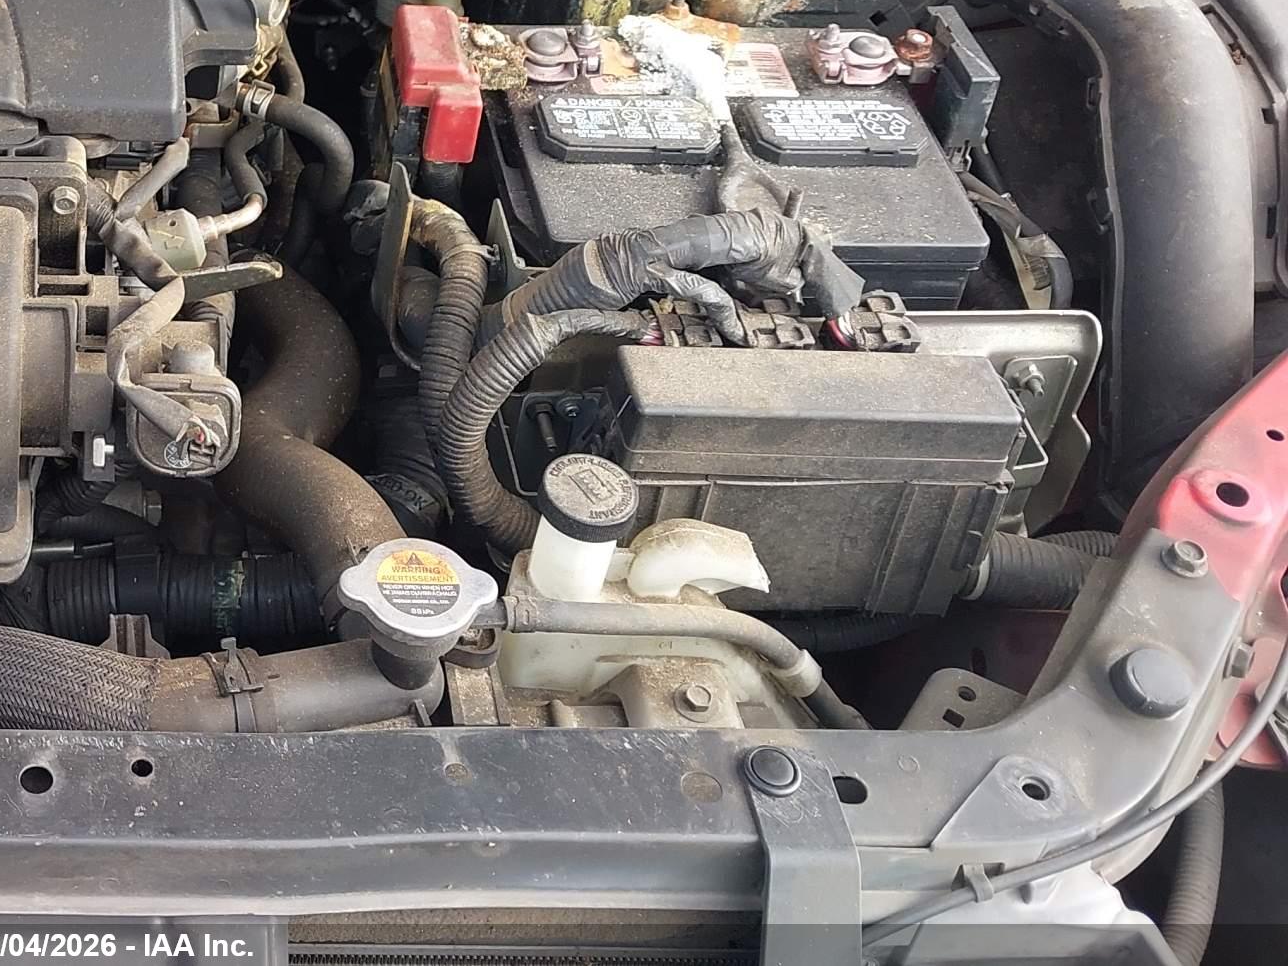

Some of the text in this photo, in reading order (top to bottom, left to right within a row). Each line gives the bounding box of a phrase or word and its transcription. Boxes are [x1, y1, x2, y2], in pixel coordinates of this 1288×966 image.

[568, 98, 622, 107] DANGER
[635, 99, 684, 107] POISON
[392, 566, 441, 574] WARNING
[381, 575, 453, 583] AVERTISSEMENT
